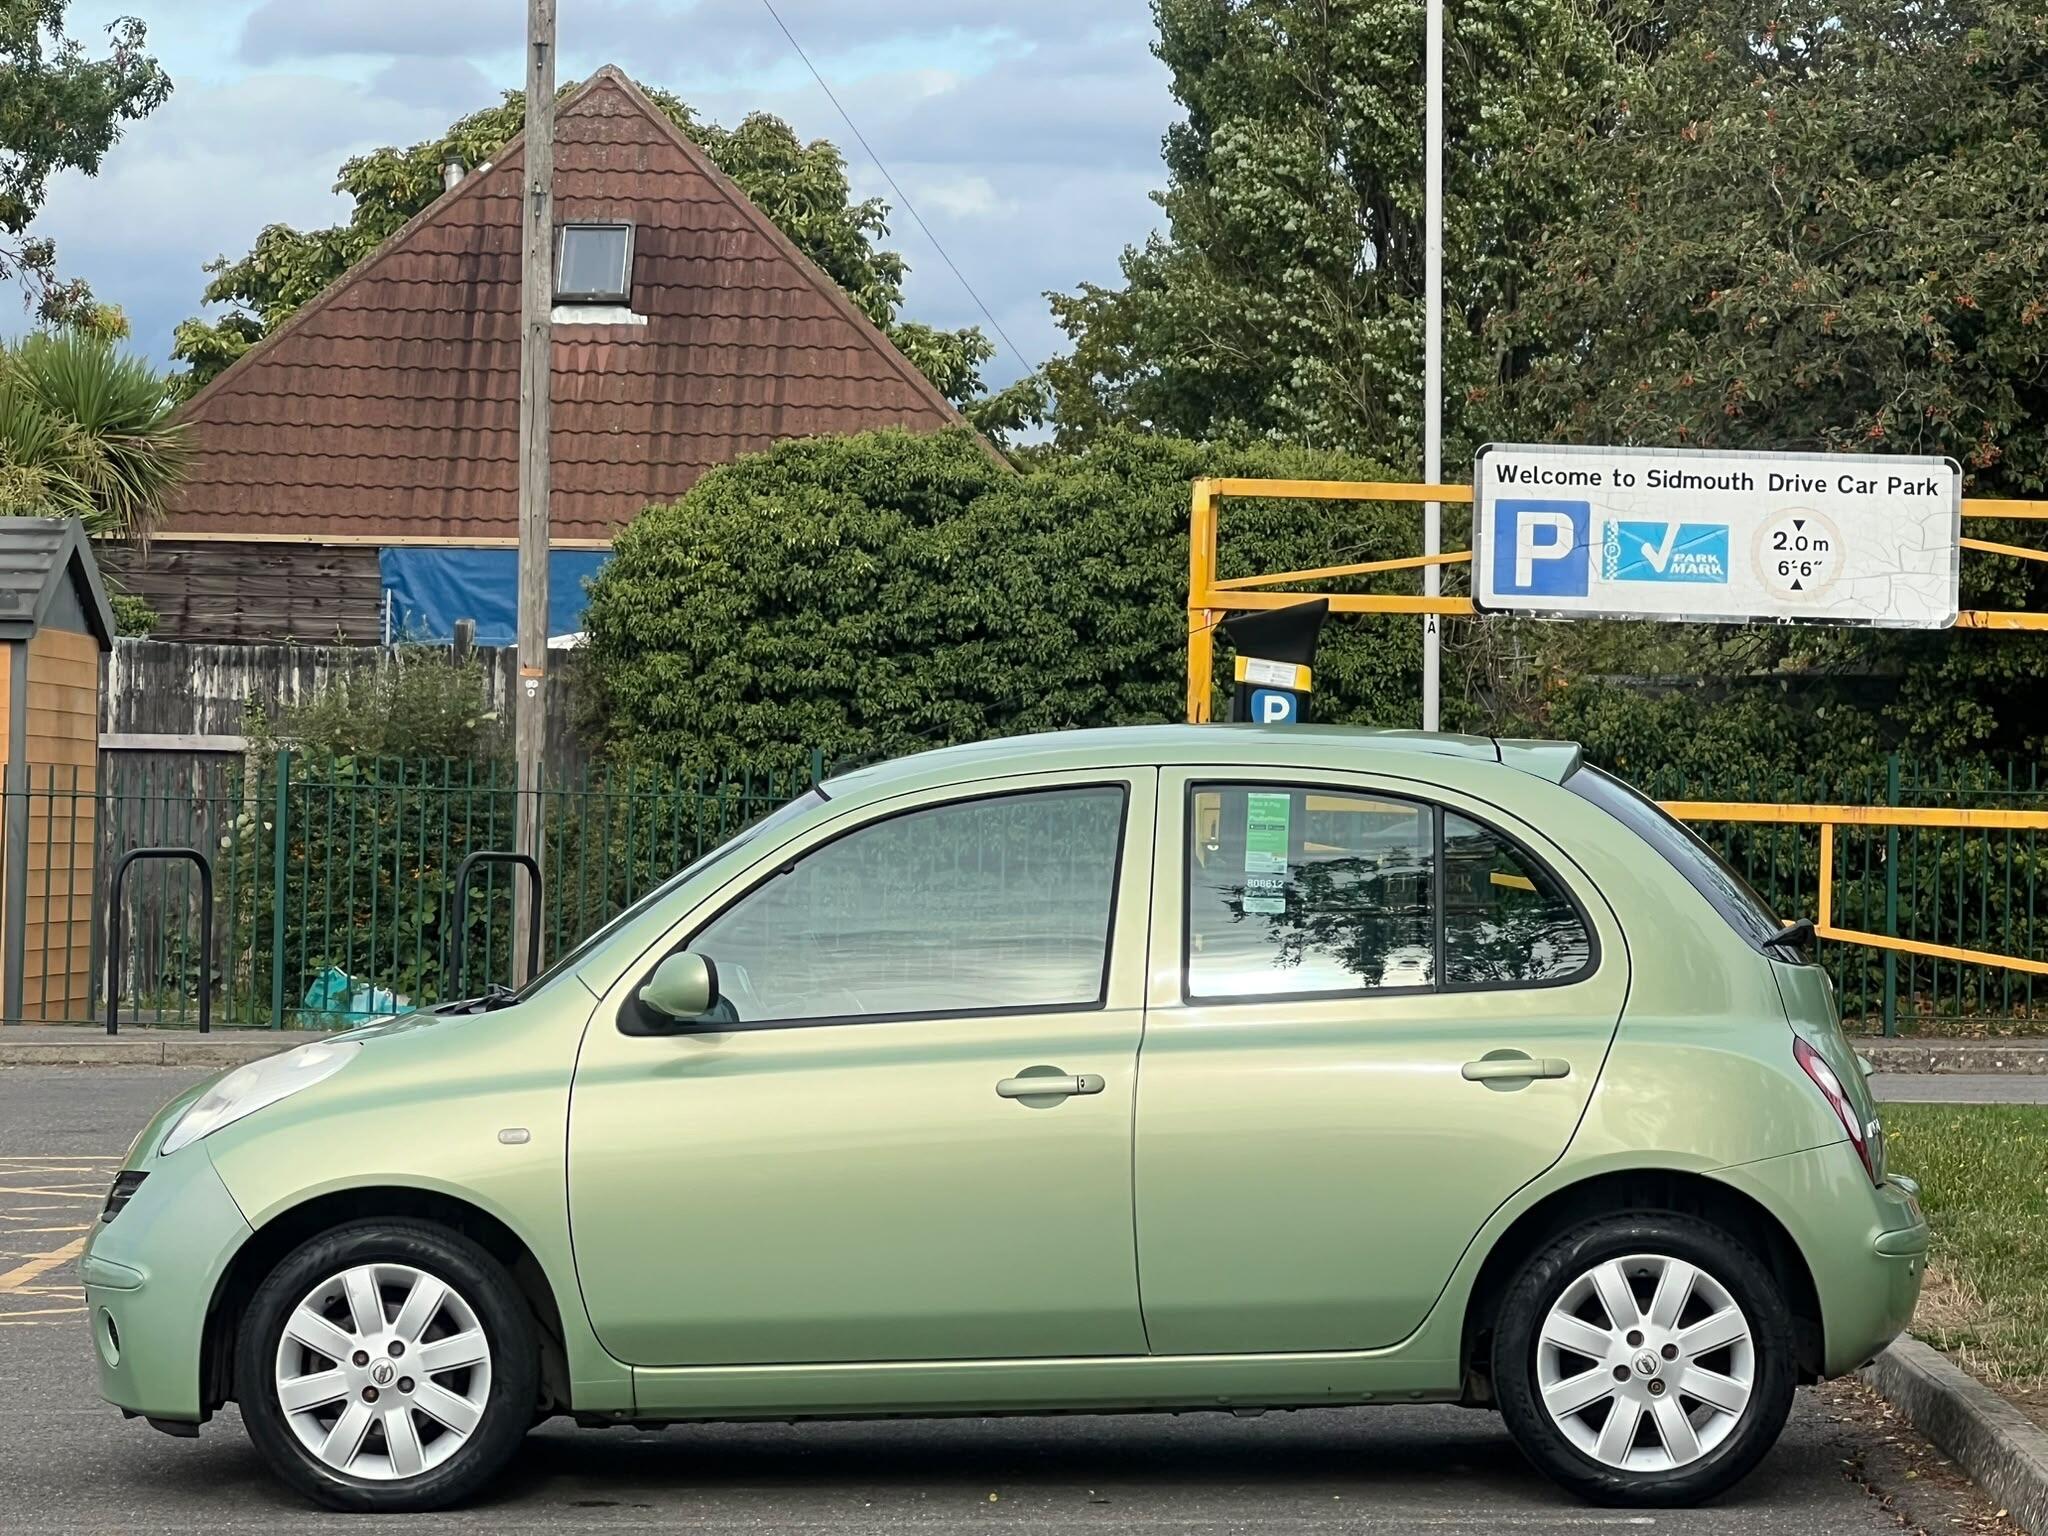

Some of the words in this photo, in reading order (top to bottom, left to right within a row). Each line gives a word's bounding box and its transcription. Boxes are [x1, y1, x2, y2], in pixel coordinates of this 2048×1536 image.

[1496, 464, 1602, 486] Welcome
[1612, 468, 1636, 487] to
[1646, 469, 1754, 491] Sidmouth
[1768, 473, 1827, 493] Drive
[1837, 475, 1878, 494] Car
[1887, 476, 1938, 496] Park
[1515, 511, 1574, 587] P
[1773, 531, 1808, 552] 2.0
[1813, 540, 1829, 552] m
[1669, 562, 1725, 576] MARK
[1672, 553, 1719, 565] PARK
[1427, 621, 1436, 634] A
[1264, 695, 1290, 723] P
